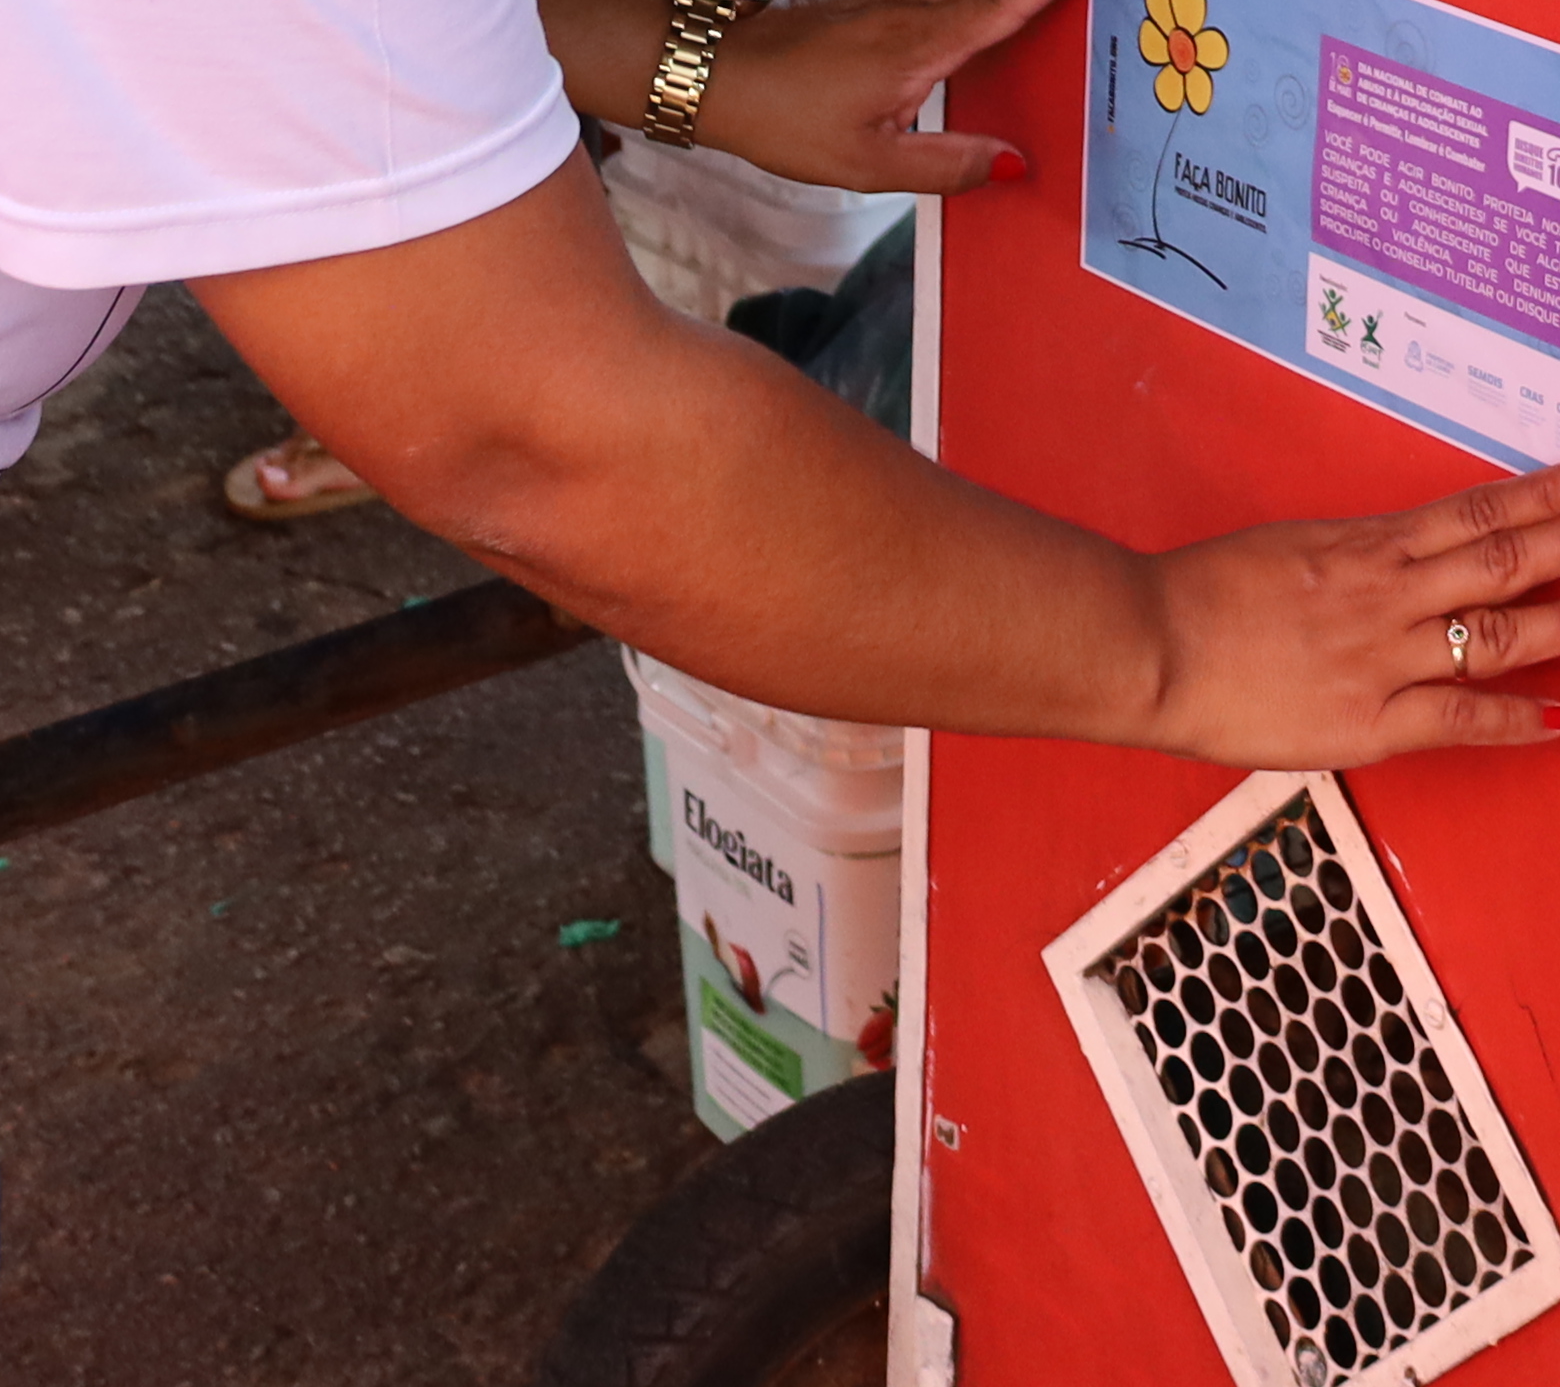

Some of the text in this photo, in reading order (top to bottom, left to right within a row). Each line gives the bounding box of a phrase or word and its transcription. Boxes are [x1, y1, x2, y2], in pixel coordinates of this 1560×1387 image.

[1356, 91, 1367, 105] DE
[1416, 83, 1428, 98] DE
[1429, 88, 1468, 114] COMBATE
[1469, 103, 1482, 119] AO
[1174, 152, 1211, 194] FAÇA
[1215, 170, 1266, 218] BONITO
[1321, 163, 1370, 195] SUSPEITA
[1380, 187, 1397, 206] OU
[1408, 198, 1498, 248] CONHECIMENTO
[1509, 240, 1526, 259] DE
[1322, 146, 1375, 182] CRIANÇAS
[1383, 170, 1391, 186] E
[1493, 215, 1508, 234] SE
[1359, 143, 1390, 168] PODE
[1397, 159, 1423, 181] AGIR
[1483, 193, 1534, 226] PROTEJA
[1319, 179, 1367, 214] CRIANÇA
[1380, 204, 1397, 223] OU
[1411, 217, 1491, 262] ADOLESCENTE
[1505, 256, 1530, 278] QUE
[1319, 197, 1377, 233] SOFRENDO
[1467, 259, 1498, 284] DEVE
[1319, 213, 1370, 247] PROCURE
[1371, 235, 1381, 252] O
[1382, 240, 1442, 278] CONSELHO
[1444, 266, 1493, 299] TUTELAR
[1496, 288, 1514, 308] OU
[1515, 296, 1559, 329] DISQUE
[1519, 386, 1544, 406] CRAS
[683, 786, 796, 908] Elogiata
